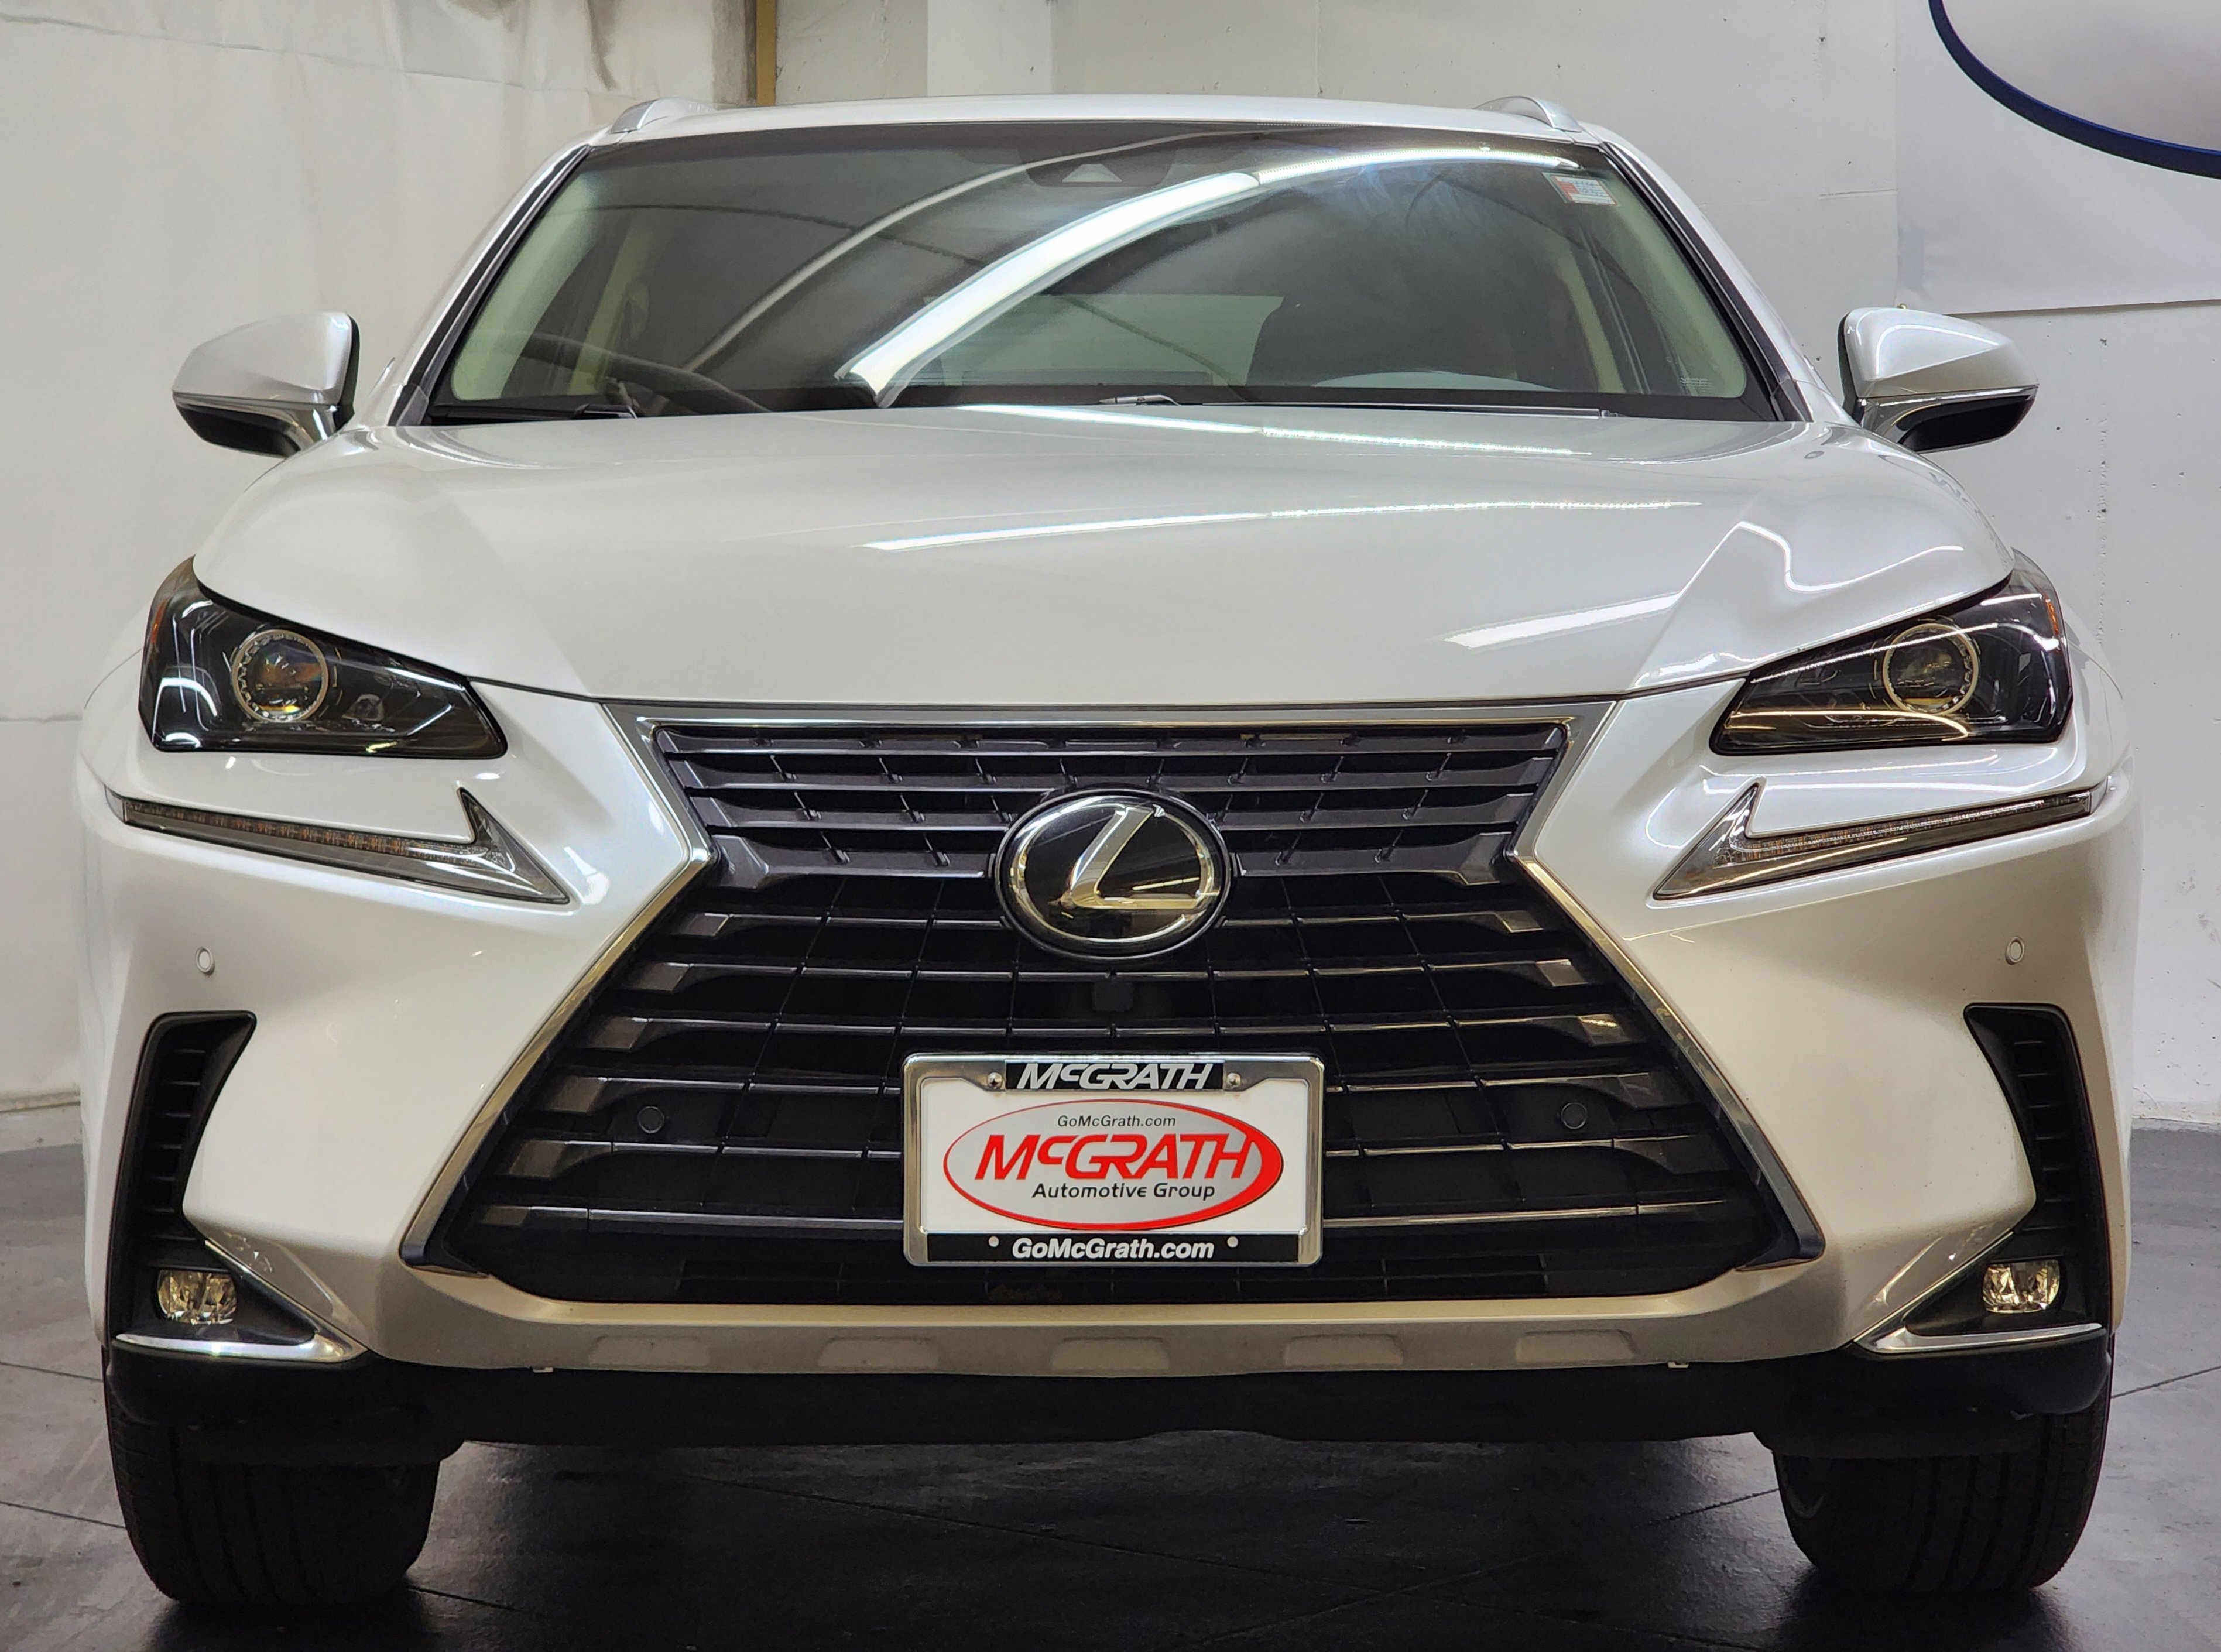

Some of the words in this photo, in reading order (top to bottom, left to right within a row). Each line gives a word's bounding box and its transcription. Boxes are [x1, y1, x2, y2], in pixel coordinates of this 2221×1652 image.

[1057, 1114, 1177, 1128] GoMcGrath.com
[1031, 1182, 1147, 1199] Automotive
[1152, 1182, 1215, 1201] Group
[1012, 1236, 1215, 1259] GoMcGrath.com
